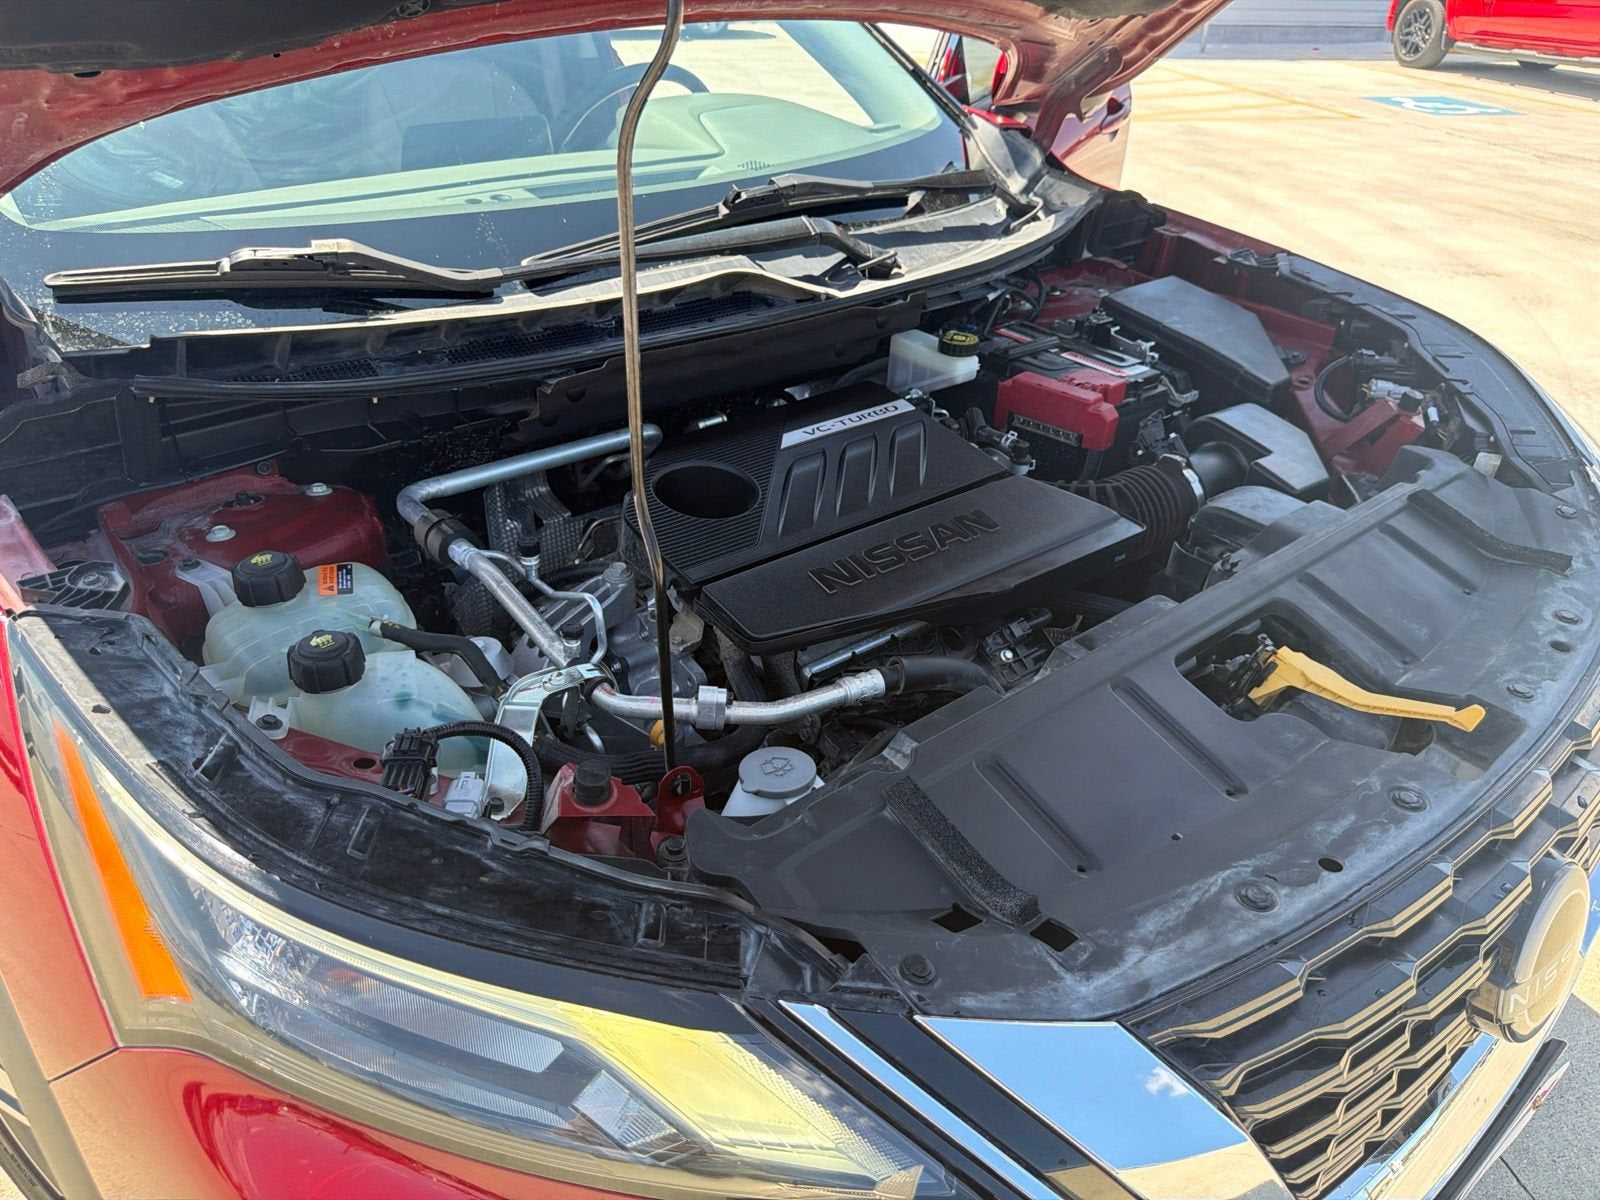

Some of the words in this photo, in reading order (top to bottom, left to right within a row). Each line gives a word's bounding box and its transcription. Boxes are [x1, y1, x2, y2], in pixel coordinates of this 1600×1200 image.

[801, 404, 900, 437] VC-TURBO
[807, 508, 1001, 595] NISSAN
[1508, 947, 1571, 1014] NISS
